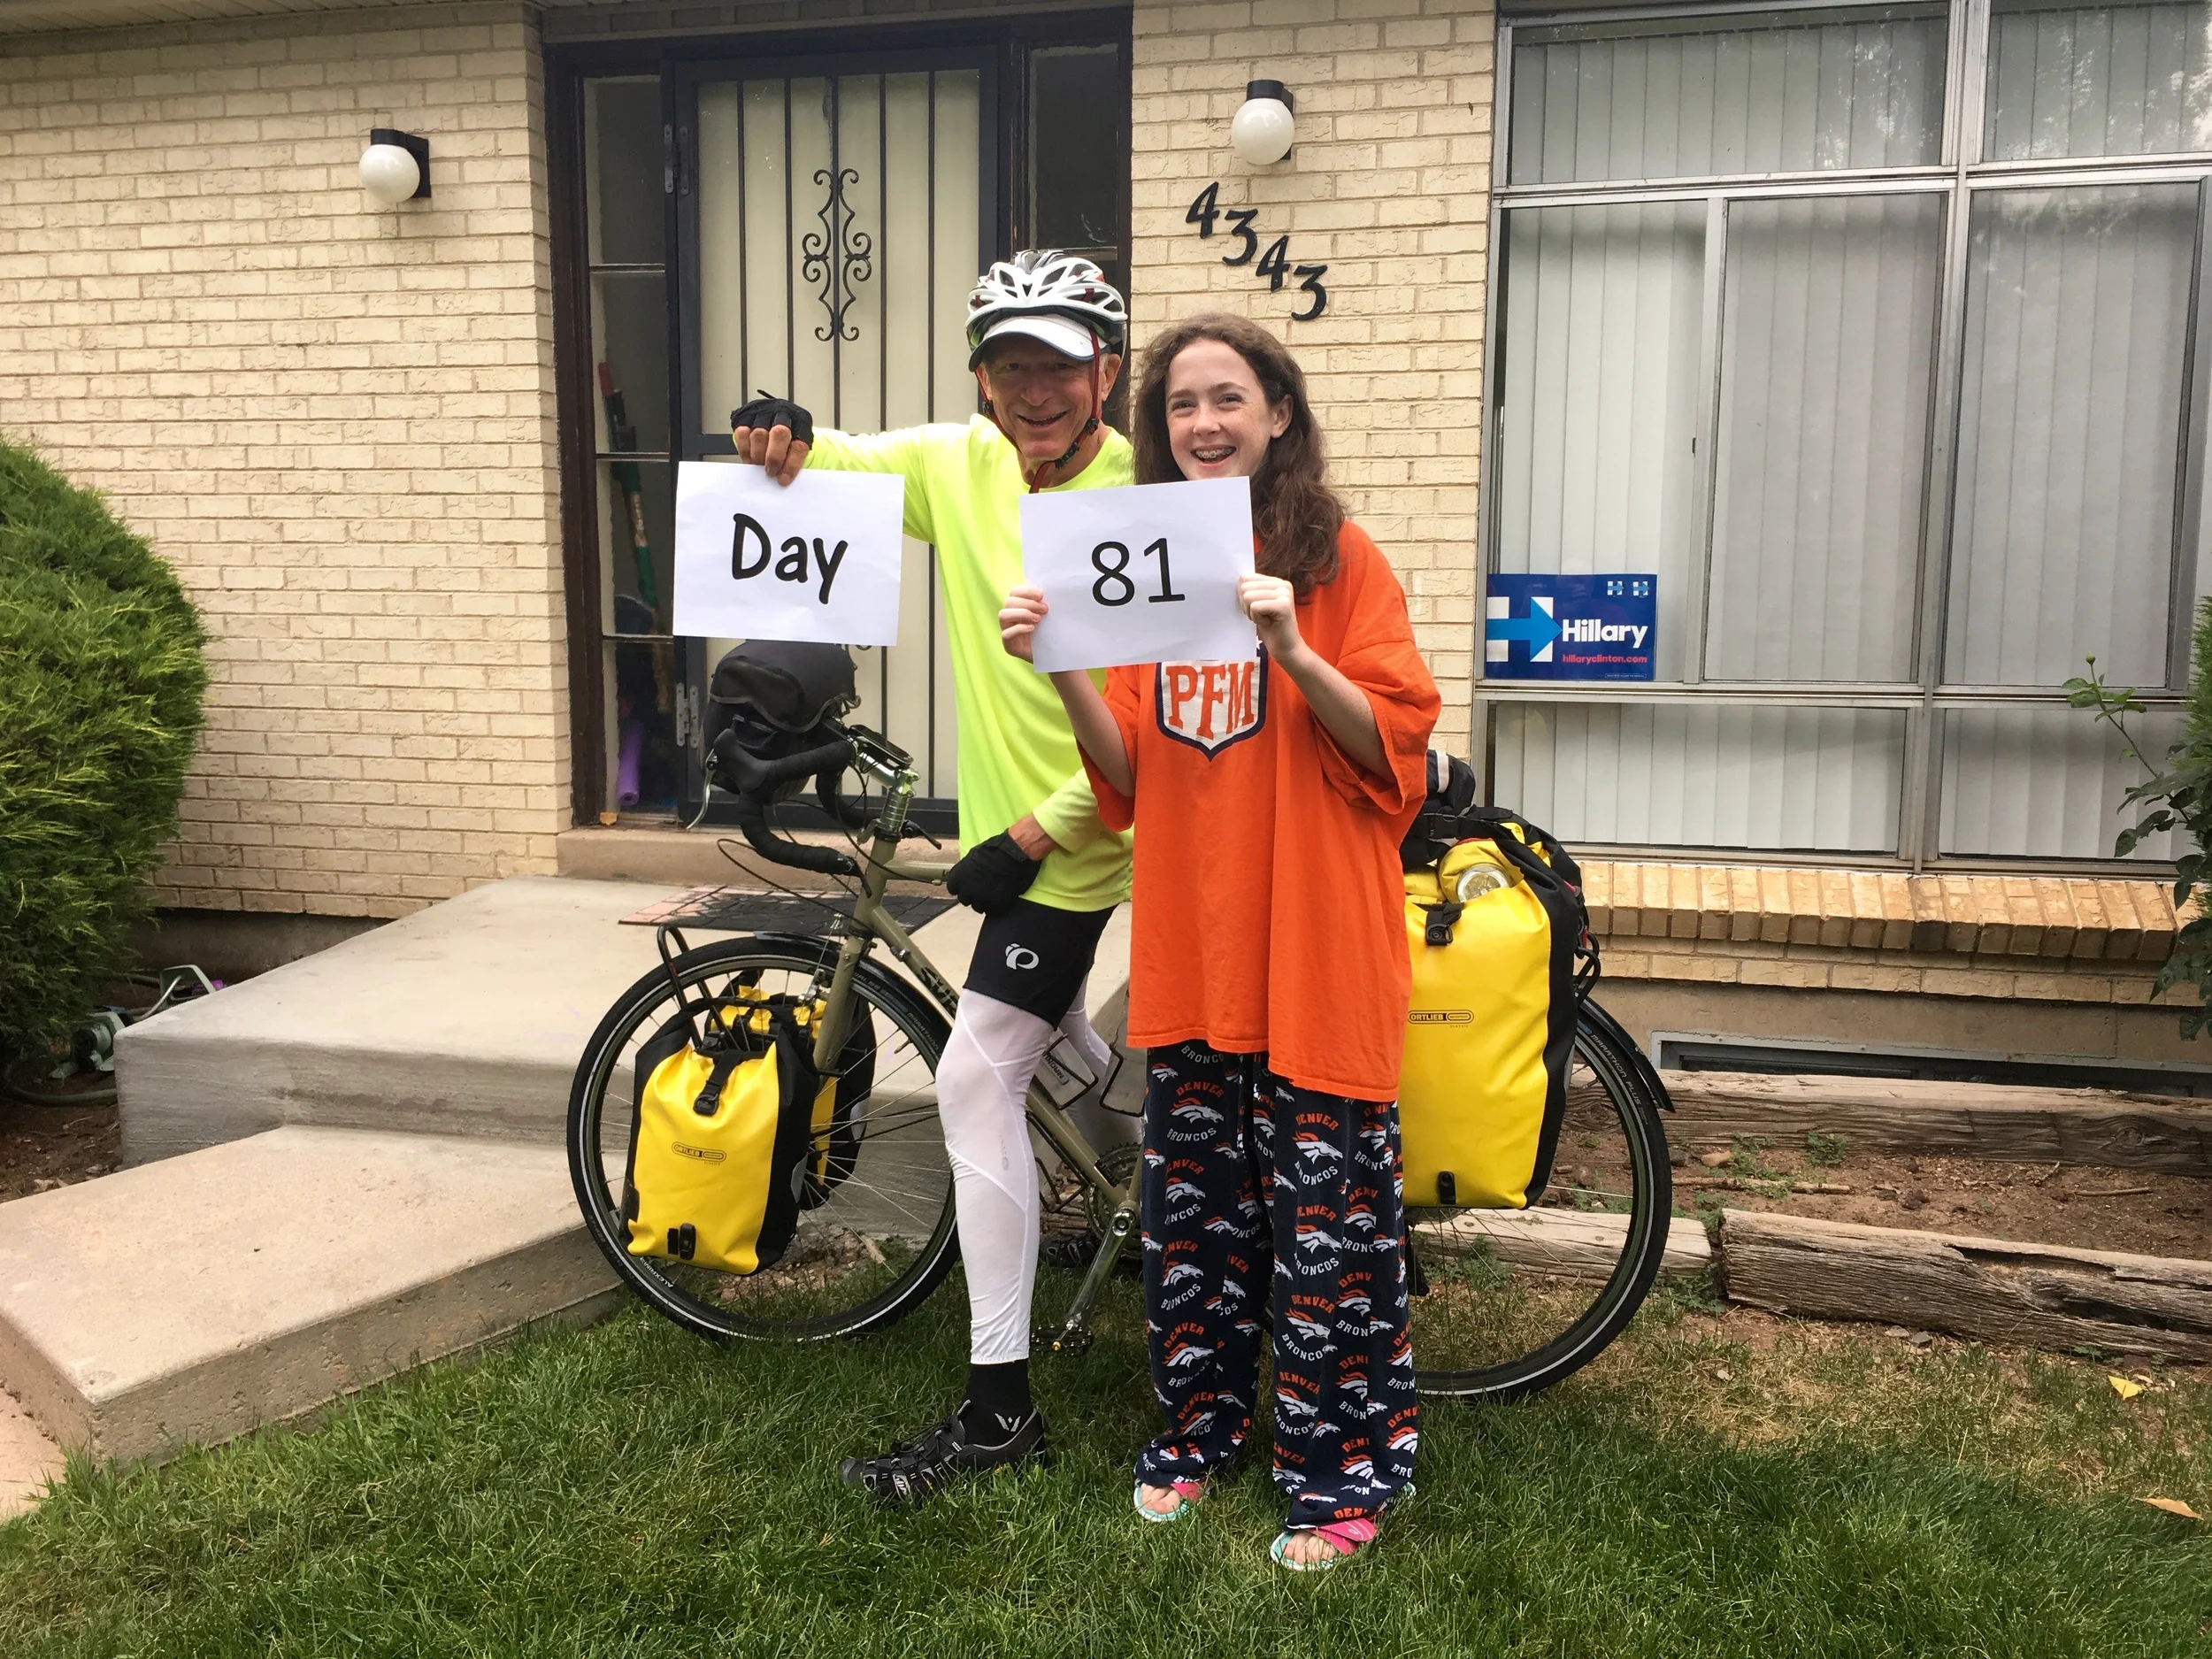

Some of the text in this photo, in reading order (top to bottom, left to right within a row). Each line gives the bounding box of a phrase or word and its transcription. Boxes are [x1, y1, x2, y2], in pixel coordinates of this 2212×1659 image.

[1186, 181, 1328, 320] 4343
[733, 512, 849, 604] Day
[1091, 537, 1185, 607] 81
[1563, 618, 1648, 649] Hillary
[1563, 654, 1647, 664] hillaryclinton.com
[1165, 662, 1255, 741] PFM
[1591, 1034, 1642, 1105] MARATHON PLUS
[1176, 1081, 1225, 1097] DENVER
[1167, 1127, 1217, 1141] BRONCOS
[1295, 1113, 1339, 1131] DENVER
[675, 1145, 701, 1156] ORTLIEB
[1294, 1161, 1339, 1186] BRONCOS
[1291, 1294, 1335, 1314] DENVER
[1164, 1322, 1204, 1348] DENVER
[1177, 1392, 1215, 1420] DENVER
